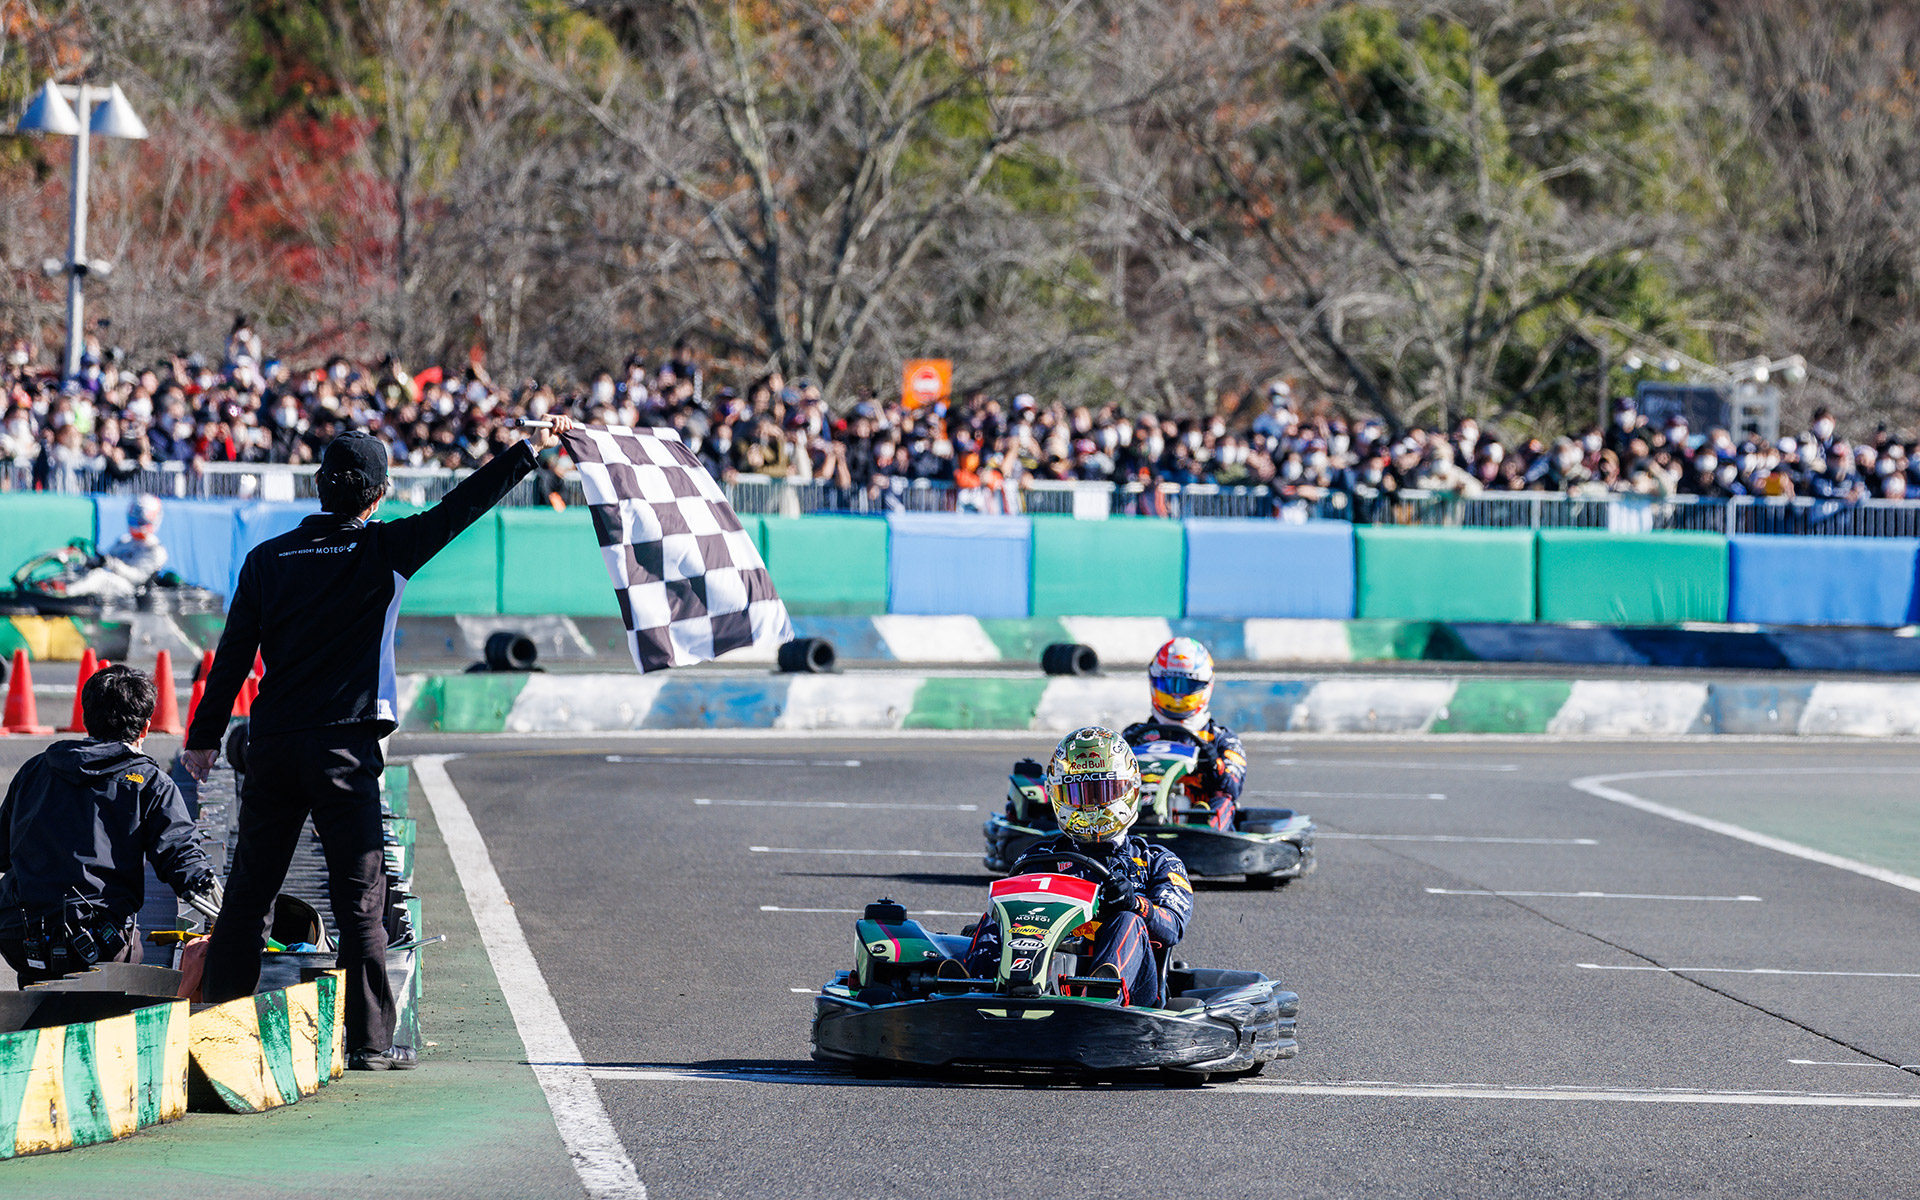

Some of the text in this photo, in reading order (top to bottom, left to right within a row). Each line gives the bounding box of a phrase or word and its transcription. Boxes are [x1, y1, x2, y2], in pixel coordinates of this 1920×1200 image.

[315, 545, 346, 555] MOTEGI
[1070, 759, 1106, 770] Red Bull
[1063, 771, 1116, 784] ORACLE
[1071, 821, 1115, 835] CarNext
[1030, 876, 1053, 891] 1
[1015, 915, 1051, 923] MOTEGI
[1011, 939, 1041, 948] Arai
